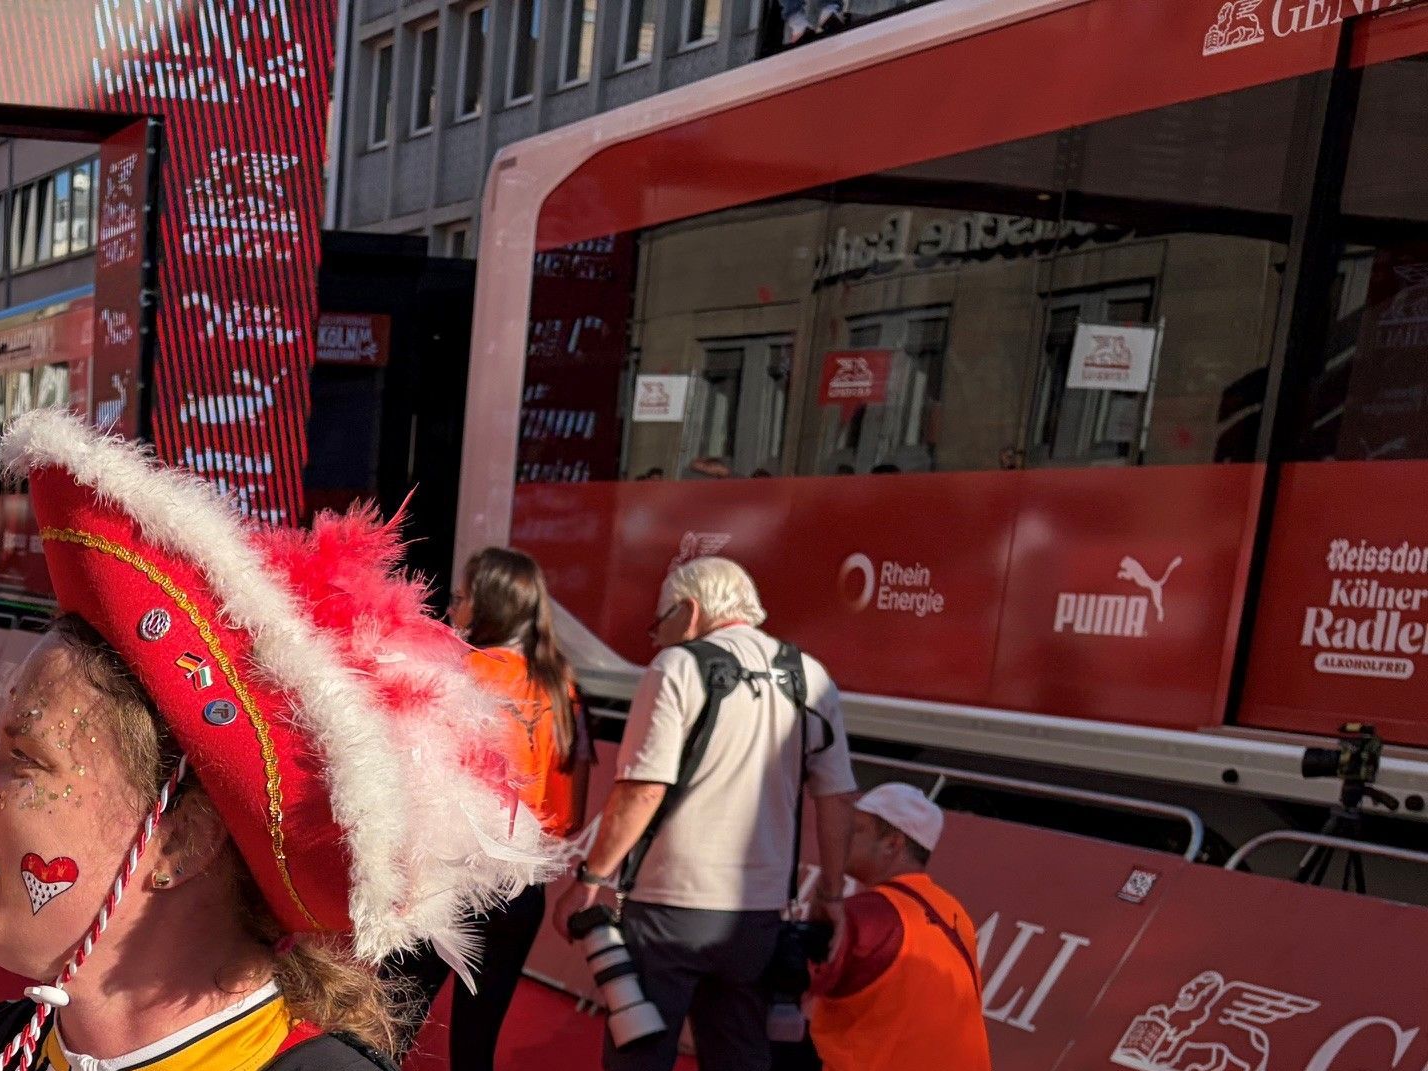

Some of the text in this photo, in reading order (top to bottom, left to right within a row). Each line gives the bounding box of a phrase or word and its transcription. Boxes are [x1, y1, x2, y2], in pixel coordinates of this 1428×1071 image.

[880, 561, 931, 588] Rhein
[876, 587, 944, 617] Energie
[1329, 578, 1428, 611] Kölner
[1053, 592, 1149, 637] PUMA
[1321, 656, 1408, 673] ALKOHOLFREI
